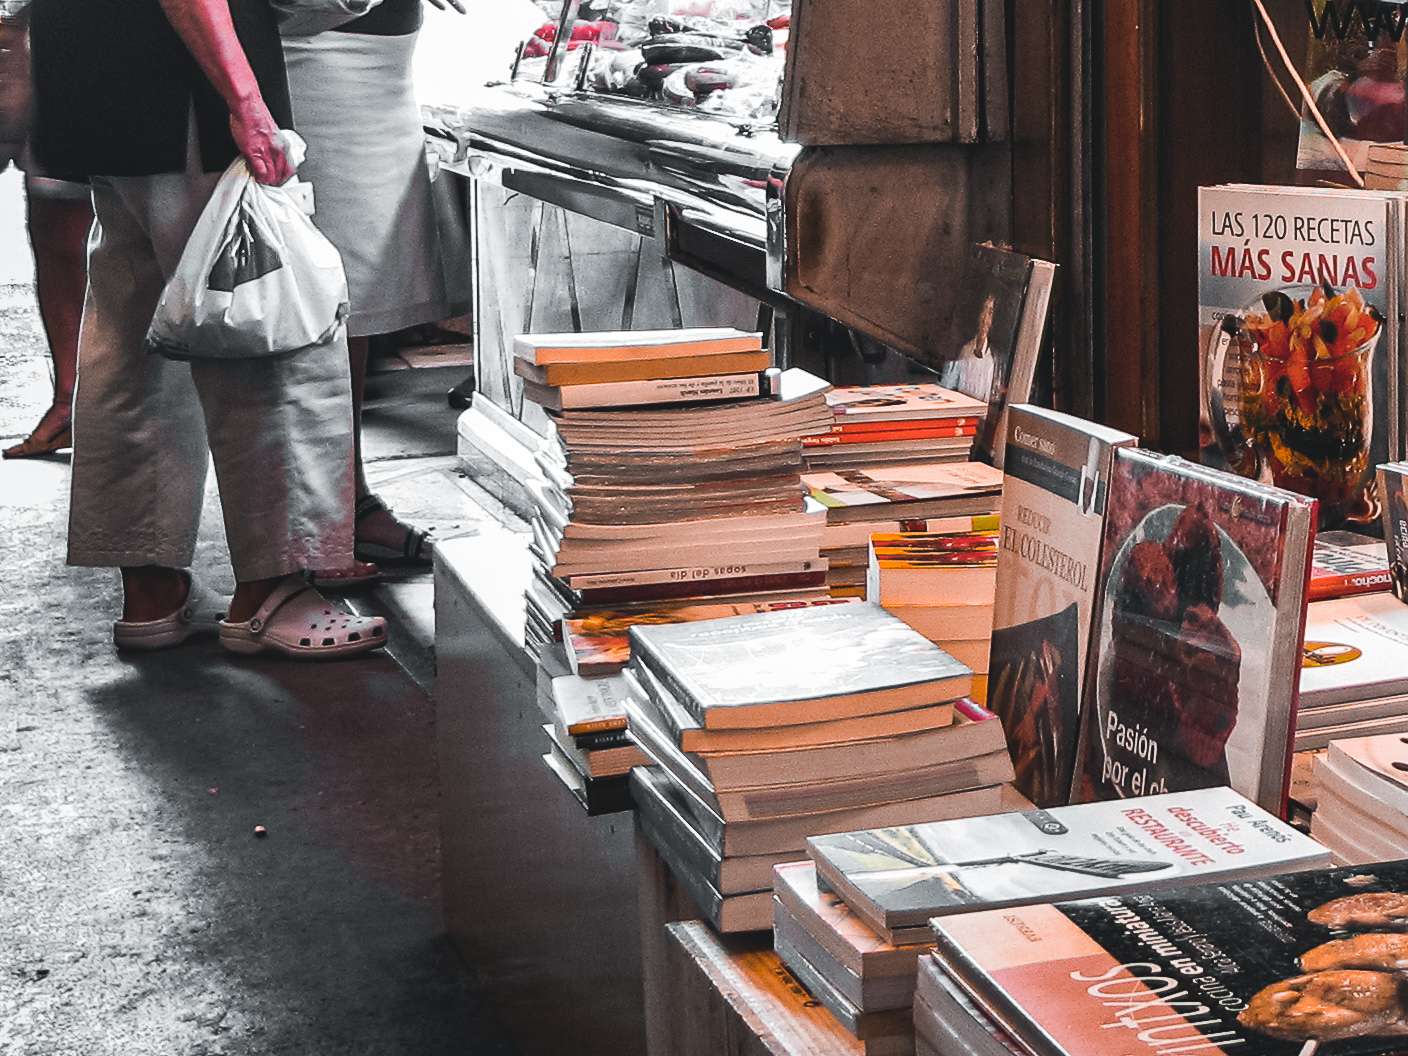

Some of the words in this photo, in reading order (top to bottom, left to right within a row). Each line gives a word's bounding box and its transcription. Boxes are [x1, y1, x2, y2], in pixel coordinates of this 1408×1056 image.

[1211, 211, 1244, 237] LAS
[1252, 213, 1287, 240] 120
[1295, 216, 1375, 246] RECETAS
[1211, 238, 1272, 281] MÁS
[1281, 250, 1377, 289] SANAS
[670, 569, 688, 581] día
[690, 567, 710, 579] del
[712, 565, 747, 576] sopas
[1003, 525, 1019, 554] EL
[1021, 534, 1088, 594] COLESTEROL
[1106, 710, 1158, 765] Pasión
[1102, 753, 1129, 786] por
[1131, 766, 1147, 796] el
[1121, 807, 1217, 867] RESTAURANTE
[1167, 805, 1246, 855] descubierto
[1098, 897, 1186, 959] miniatura
[1167, 957, 1201, 976] en
[1184, 974, 1250, 1011] cocina
